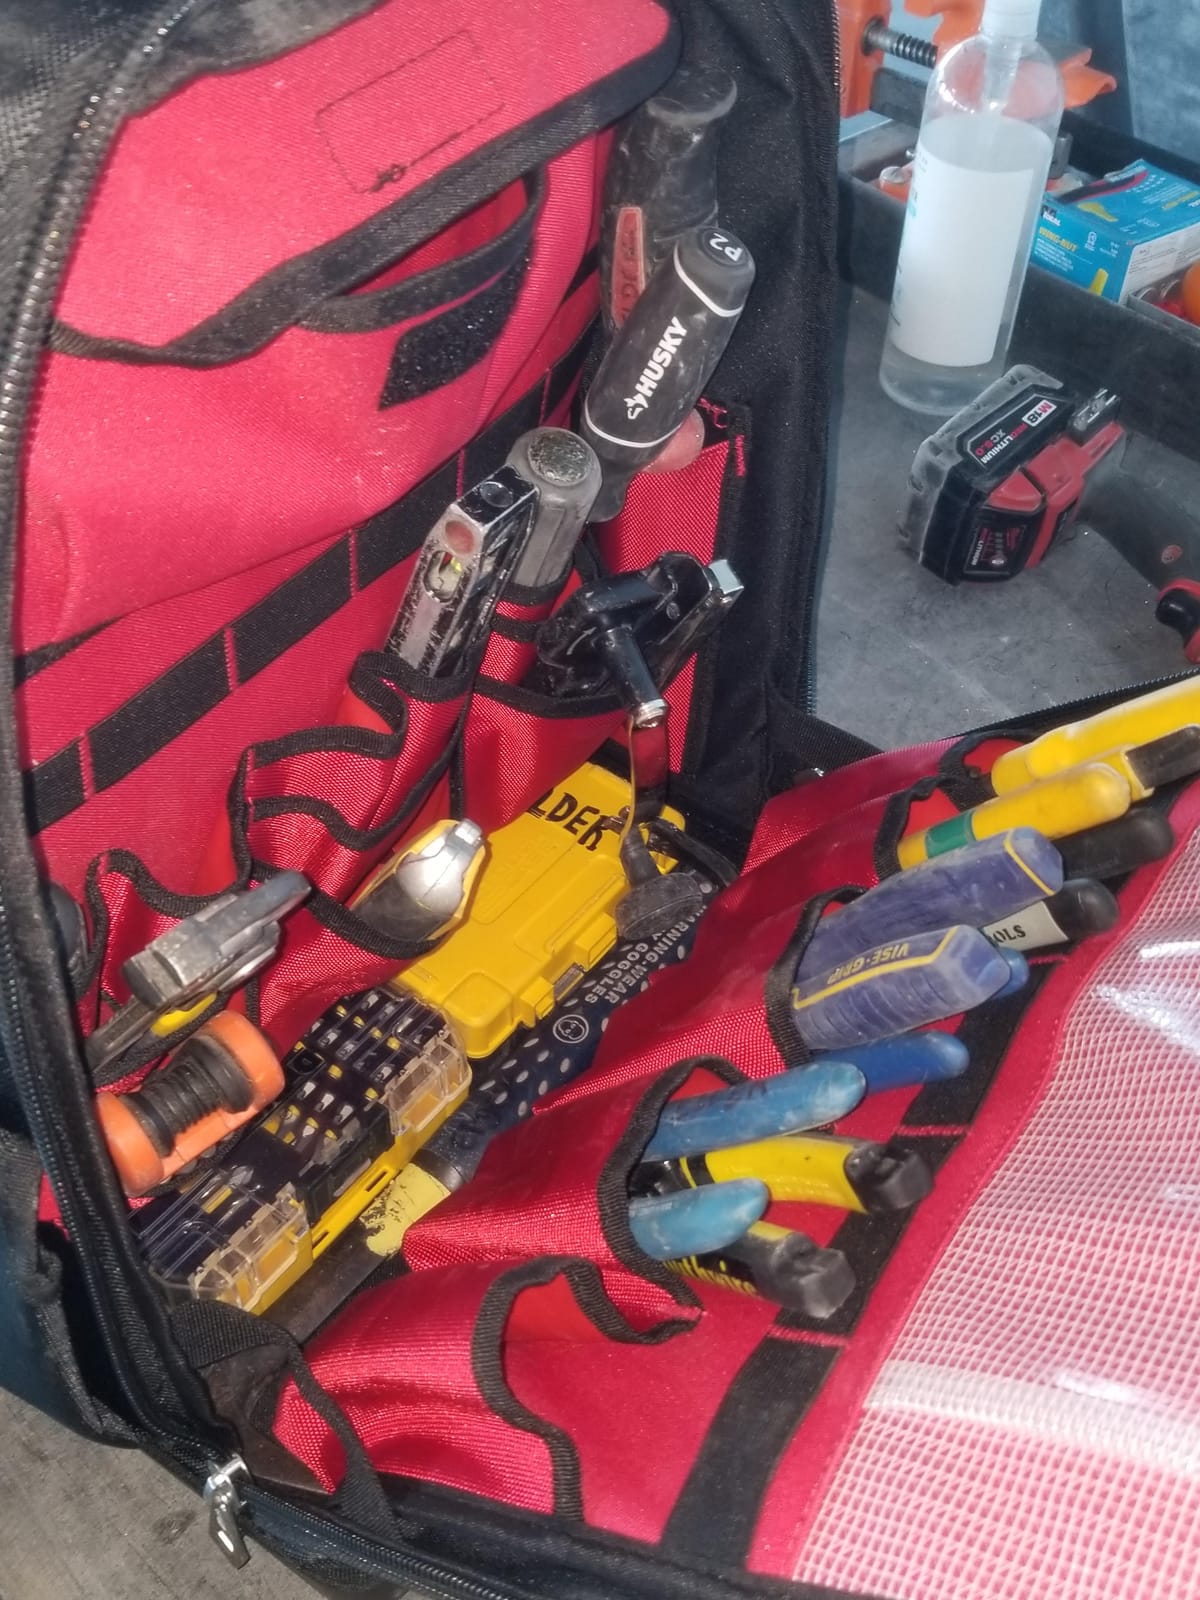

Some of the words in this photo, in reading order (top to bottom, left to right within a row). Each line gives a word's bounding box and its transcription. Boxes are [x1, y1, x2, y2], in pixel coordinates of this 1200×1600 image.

[709, 232, 743, 262] P2
[635, 316, 688, 398] HUSKY
[1026, 402, 1054, 424] M18
[584, 942, 649, 1004] GOGGLES
